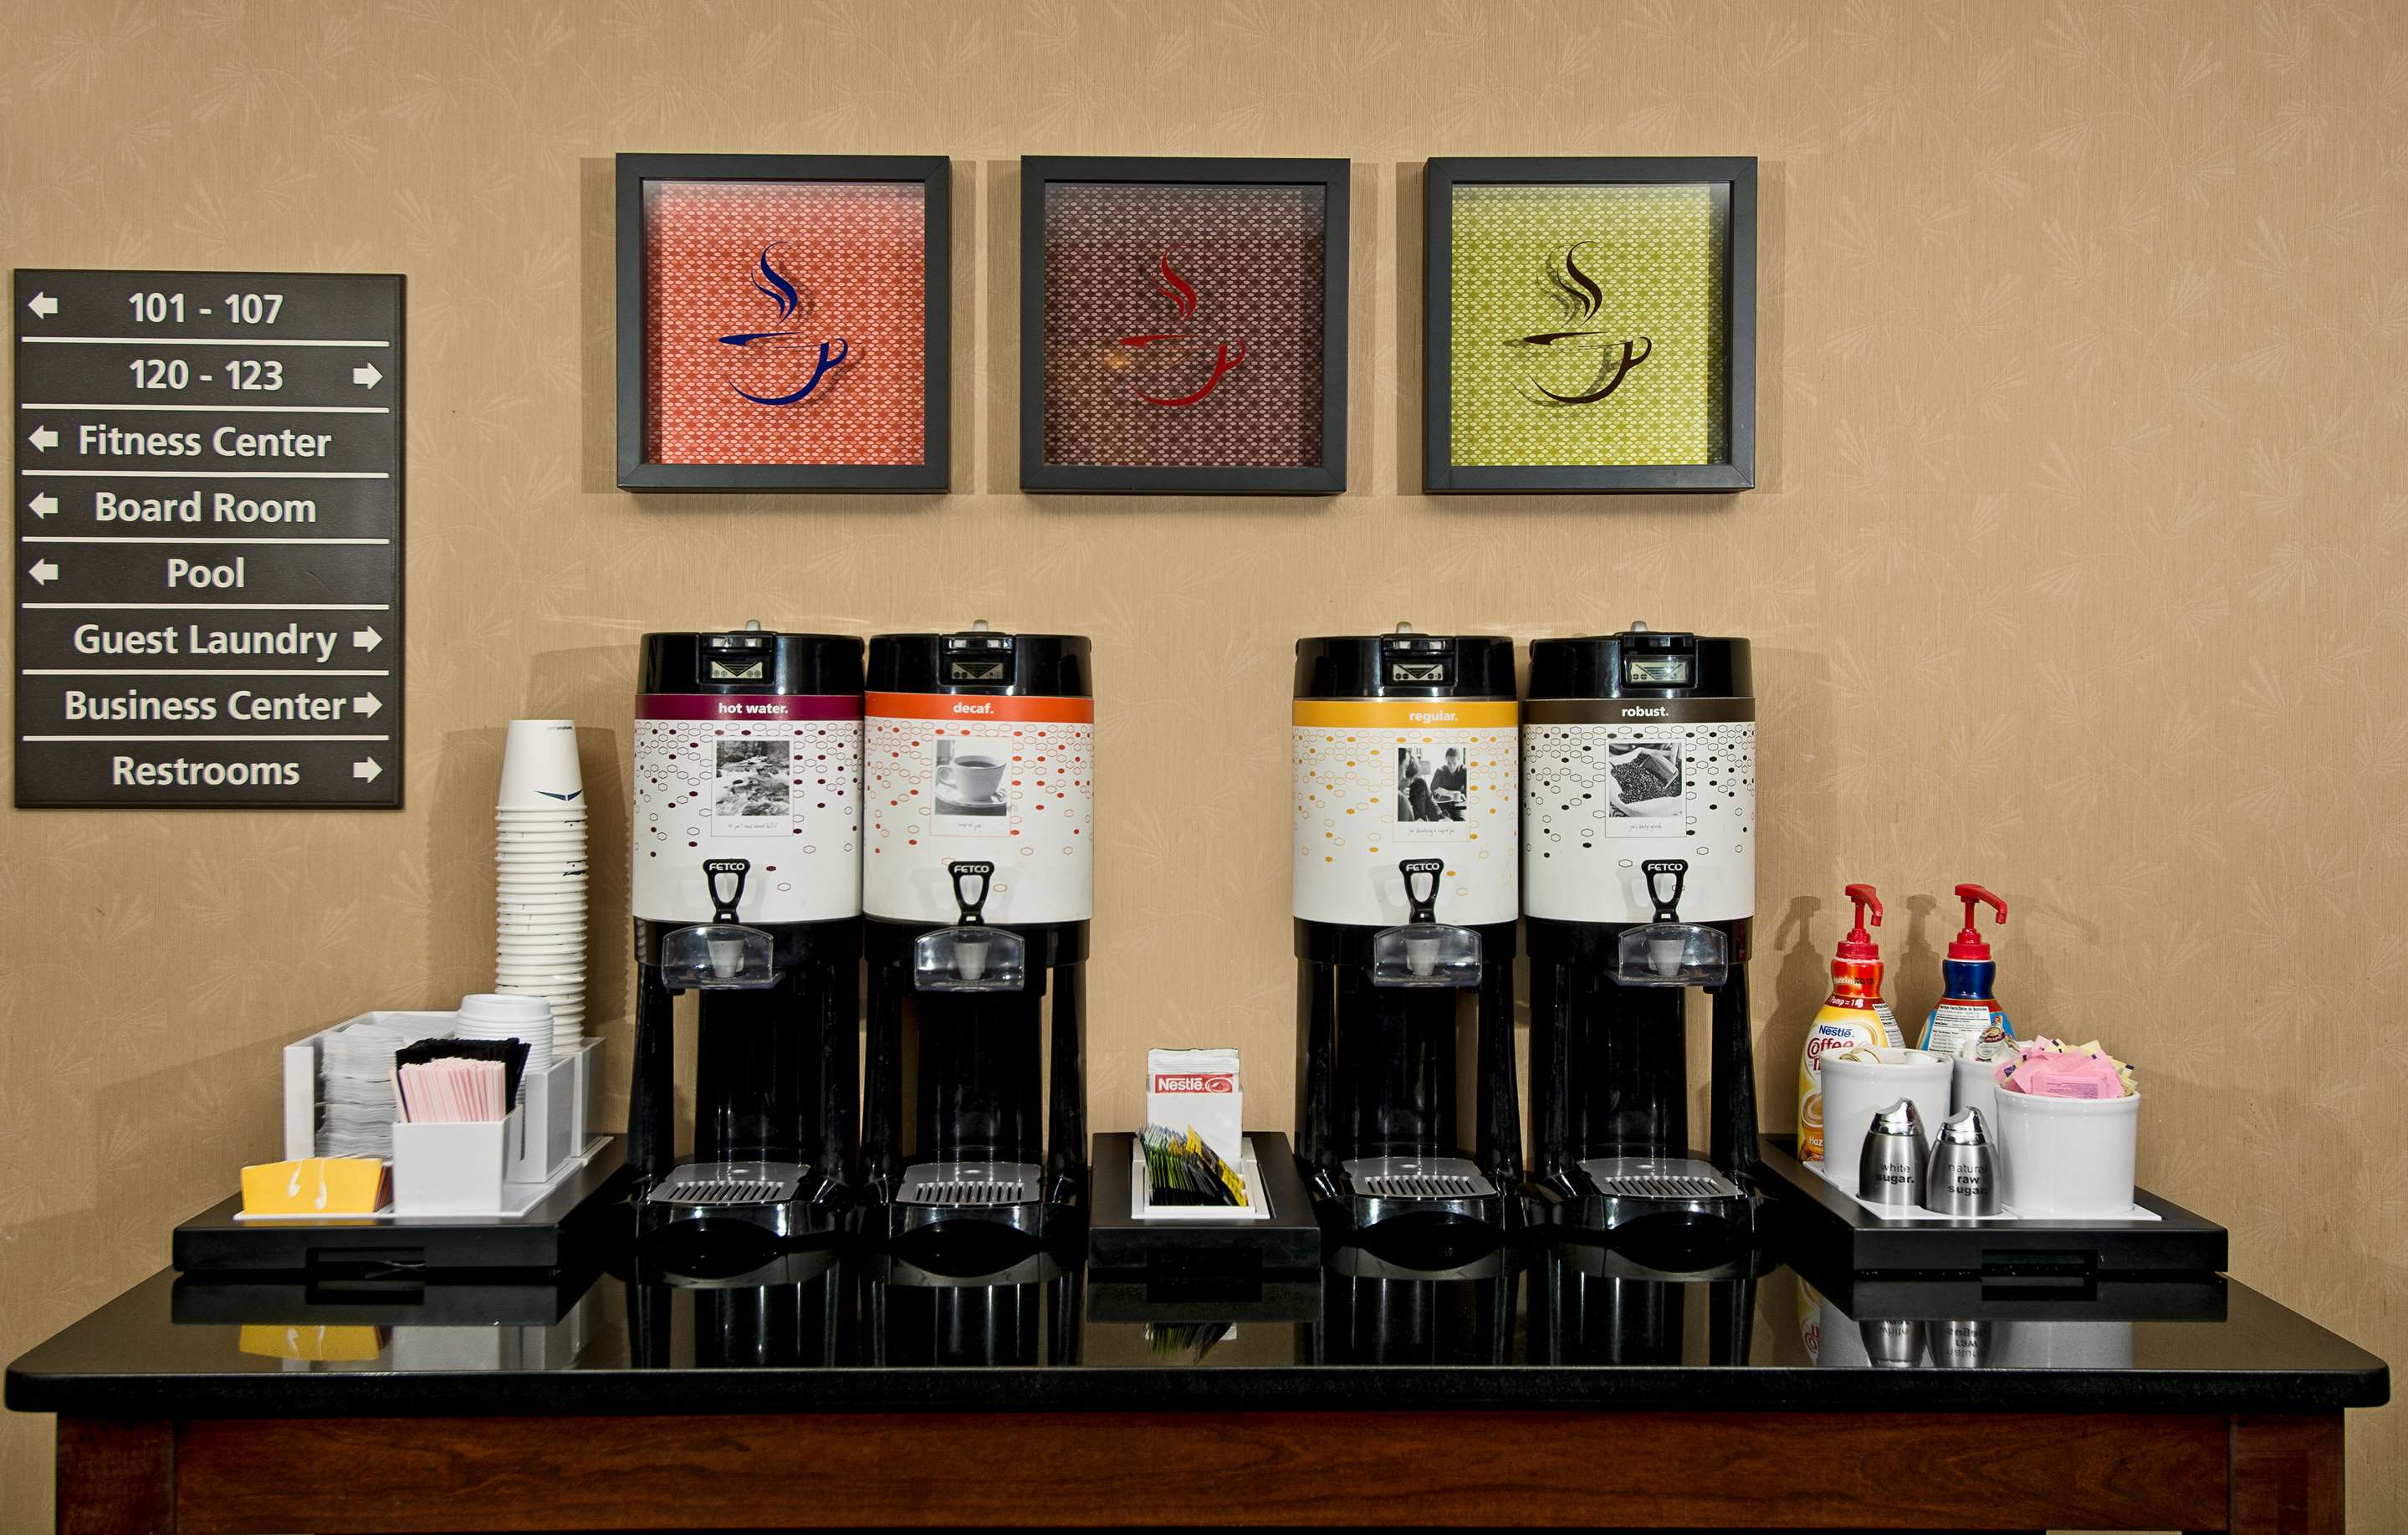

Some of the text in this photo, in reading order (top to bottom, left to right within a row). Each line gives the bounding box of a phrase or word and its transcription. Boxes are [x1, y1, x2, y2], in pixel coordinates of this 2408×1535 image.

[128, 292, 185, 323] 101
[224, 294, 284, 324] 107
[129, 359, 189, 390] 120
[224, 360, 284, 391] 123
[79, 424, 332, 458] Fitness Center
[95, 490, 316, 523] Board Room
[167, 556, 245, 588] Pool
[74, 622, 338, 663] Guest Laundry
[65, 688, 347, 720] Business Center
[718, 702, 789, 714] hot water.
[953, 702, 994, 714] decaf.
[1409, 710, 1459, 724] regular.
[1621, 705, 1669, 718] robust.
[113, 755, 300, 785] Restrooms
[708, 862, 745, 872] FETCO
[953, 865, 989, 874] FETCO
[1405, 862, 1440, 872] FETCO
[1647, 863, 1684, 872] FETCO
[1881, 1164, 1910, 1172] white
[1948, 1164, 1987, 1174] natural
[1875, 1174, 1915, 1185] sugar.
[1957, 1175, 1980, 1185] raw
[1948, 1185, 1988, 1196] sugar.
